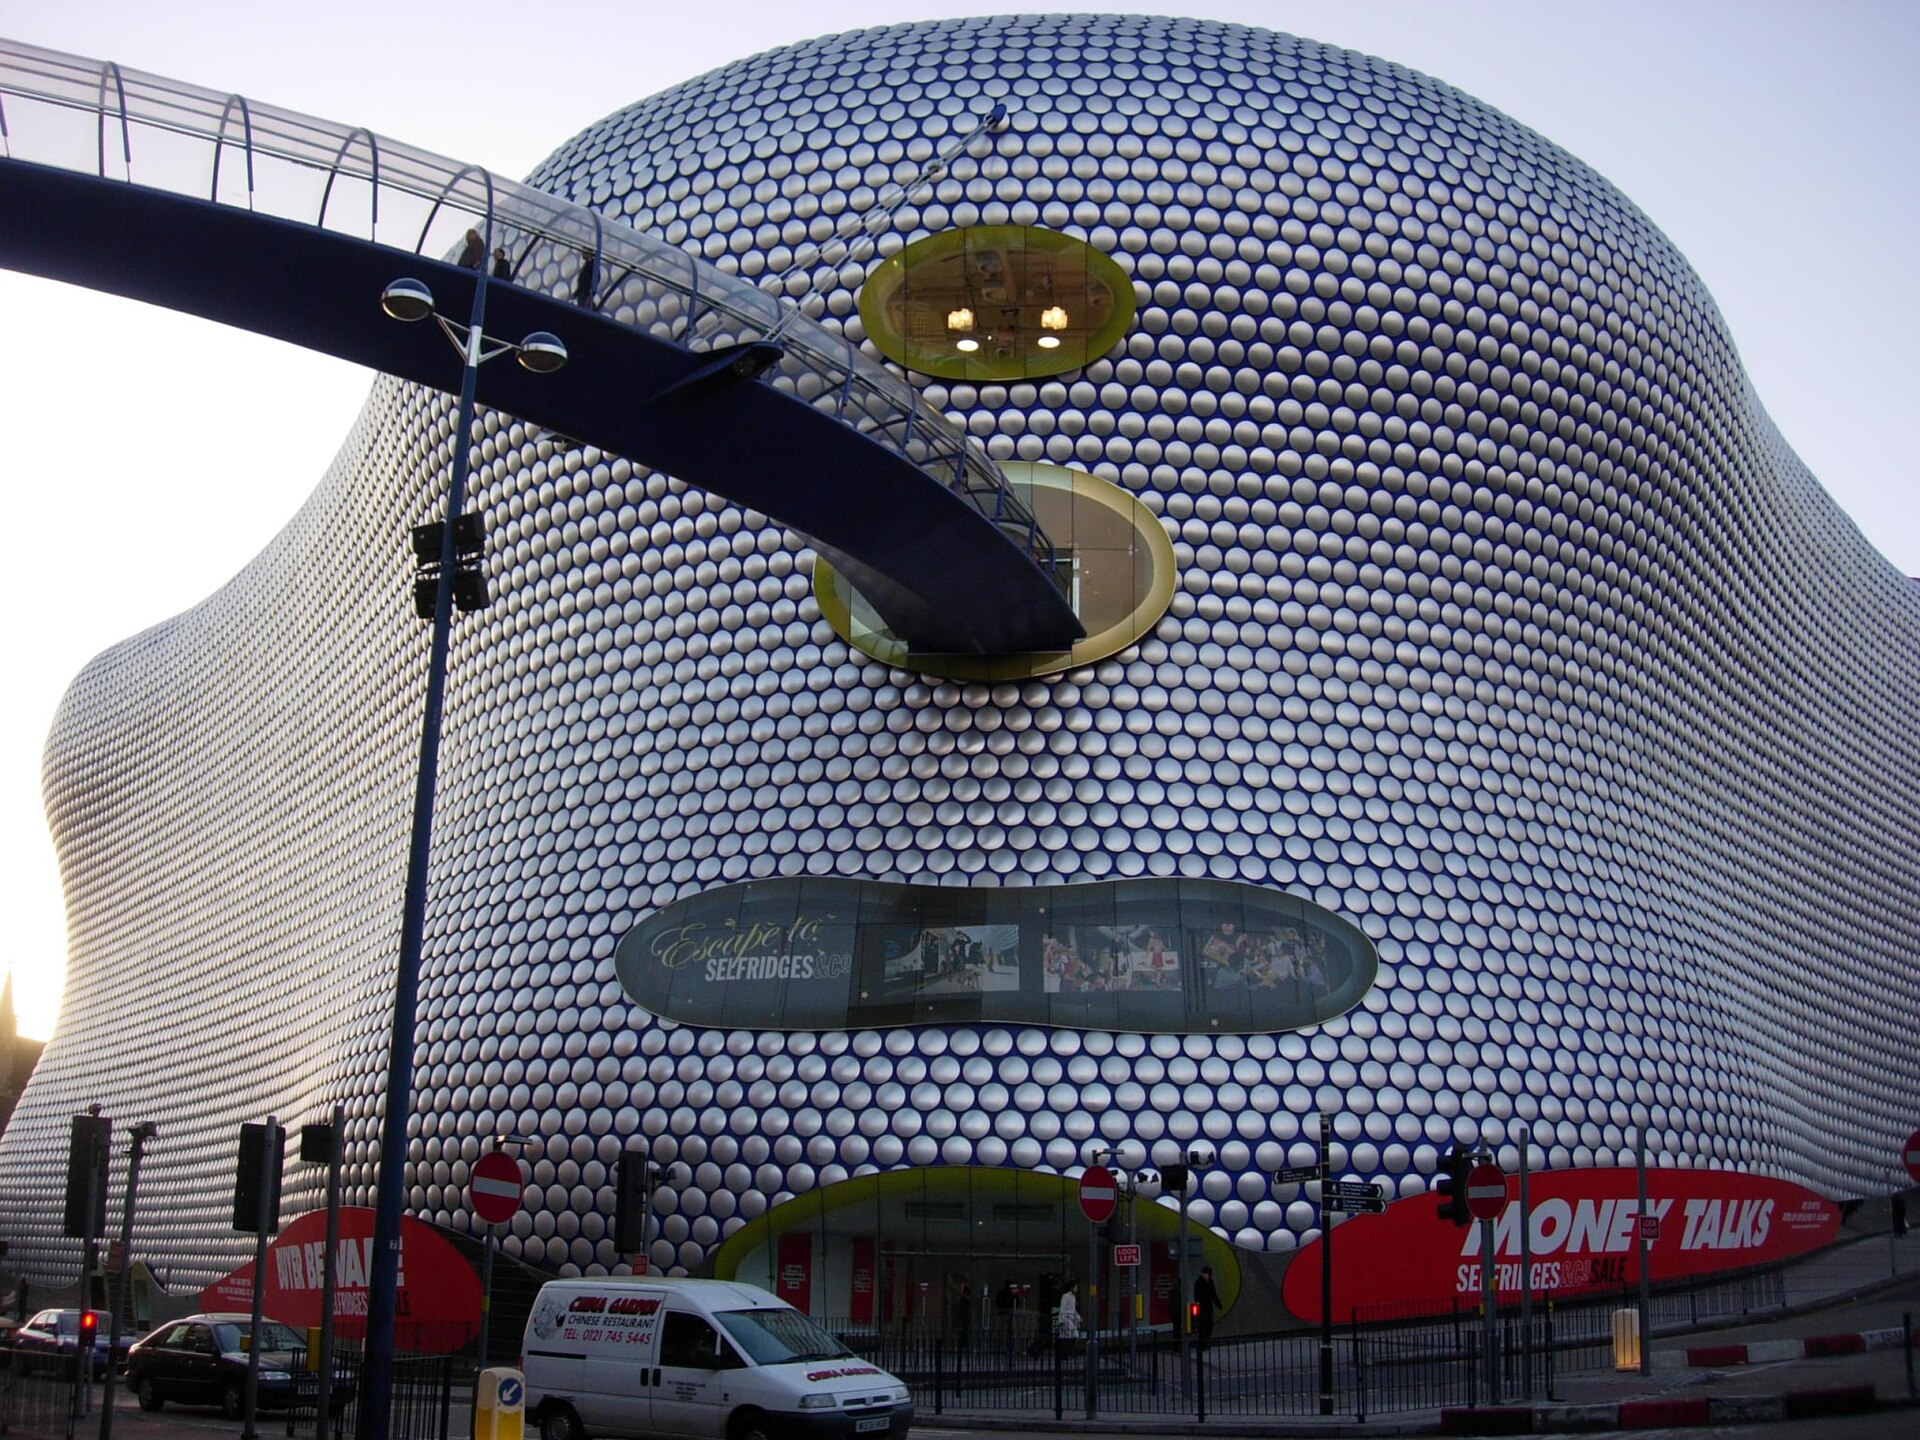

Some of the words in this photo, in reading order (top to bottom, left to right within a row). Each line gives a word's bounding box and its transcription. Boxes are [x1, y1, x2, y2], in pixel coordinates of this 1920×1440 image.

[650, 922, 781, 970] Escape
[788, 915, 824, 942] to
[1680, 1197, 1775, 1250] TALKS
[1588, 1257, 1628, 1285] SALE
[568, 1296, 608, 1313] CHINA
[568, 1315, 601, 1326] CHINESE
[602, 1316, 655, 1329] RESTAURANT
[583, 1329, 603, 1342] 0121
[605, 1330, 624, 1343] 745
[626, 1331, 652, 1345] 5445
